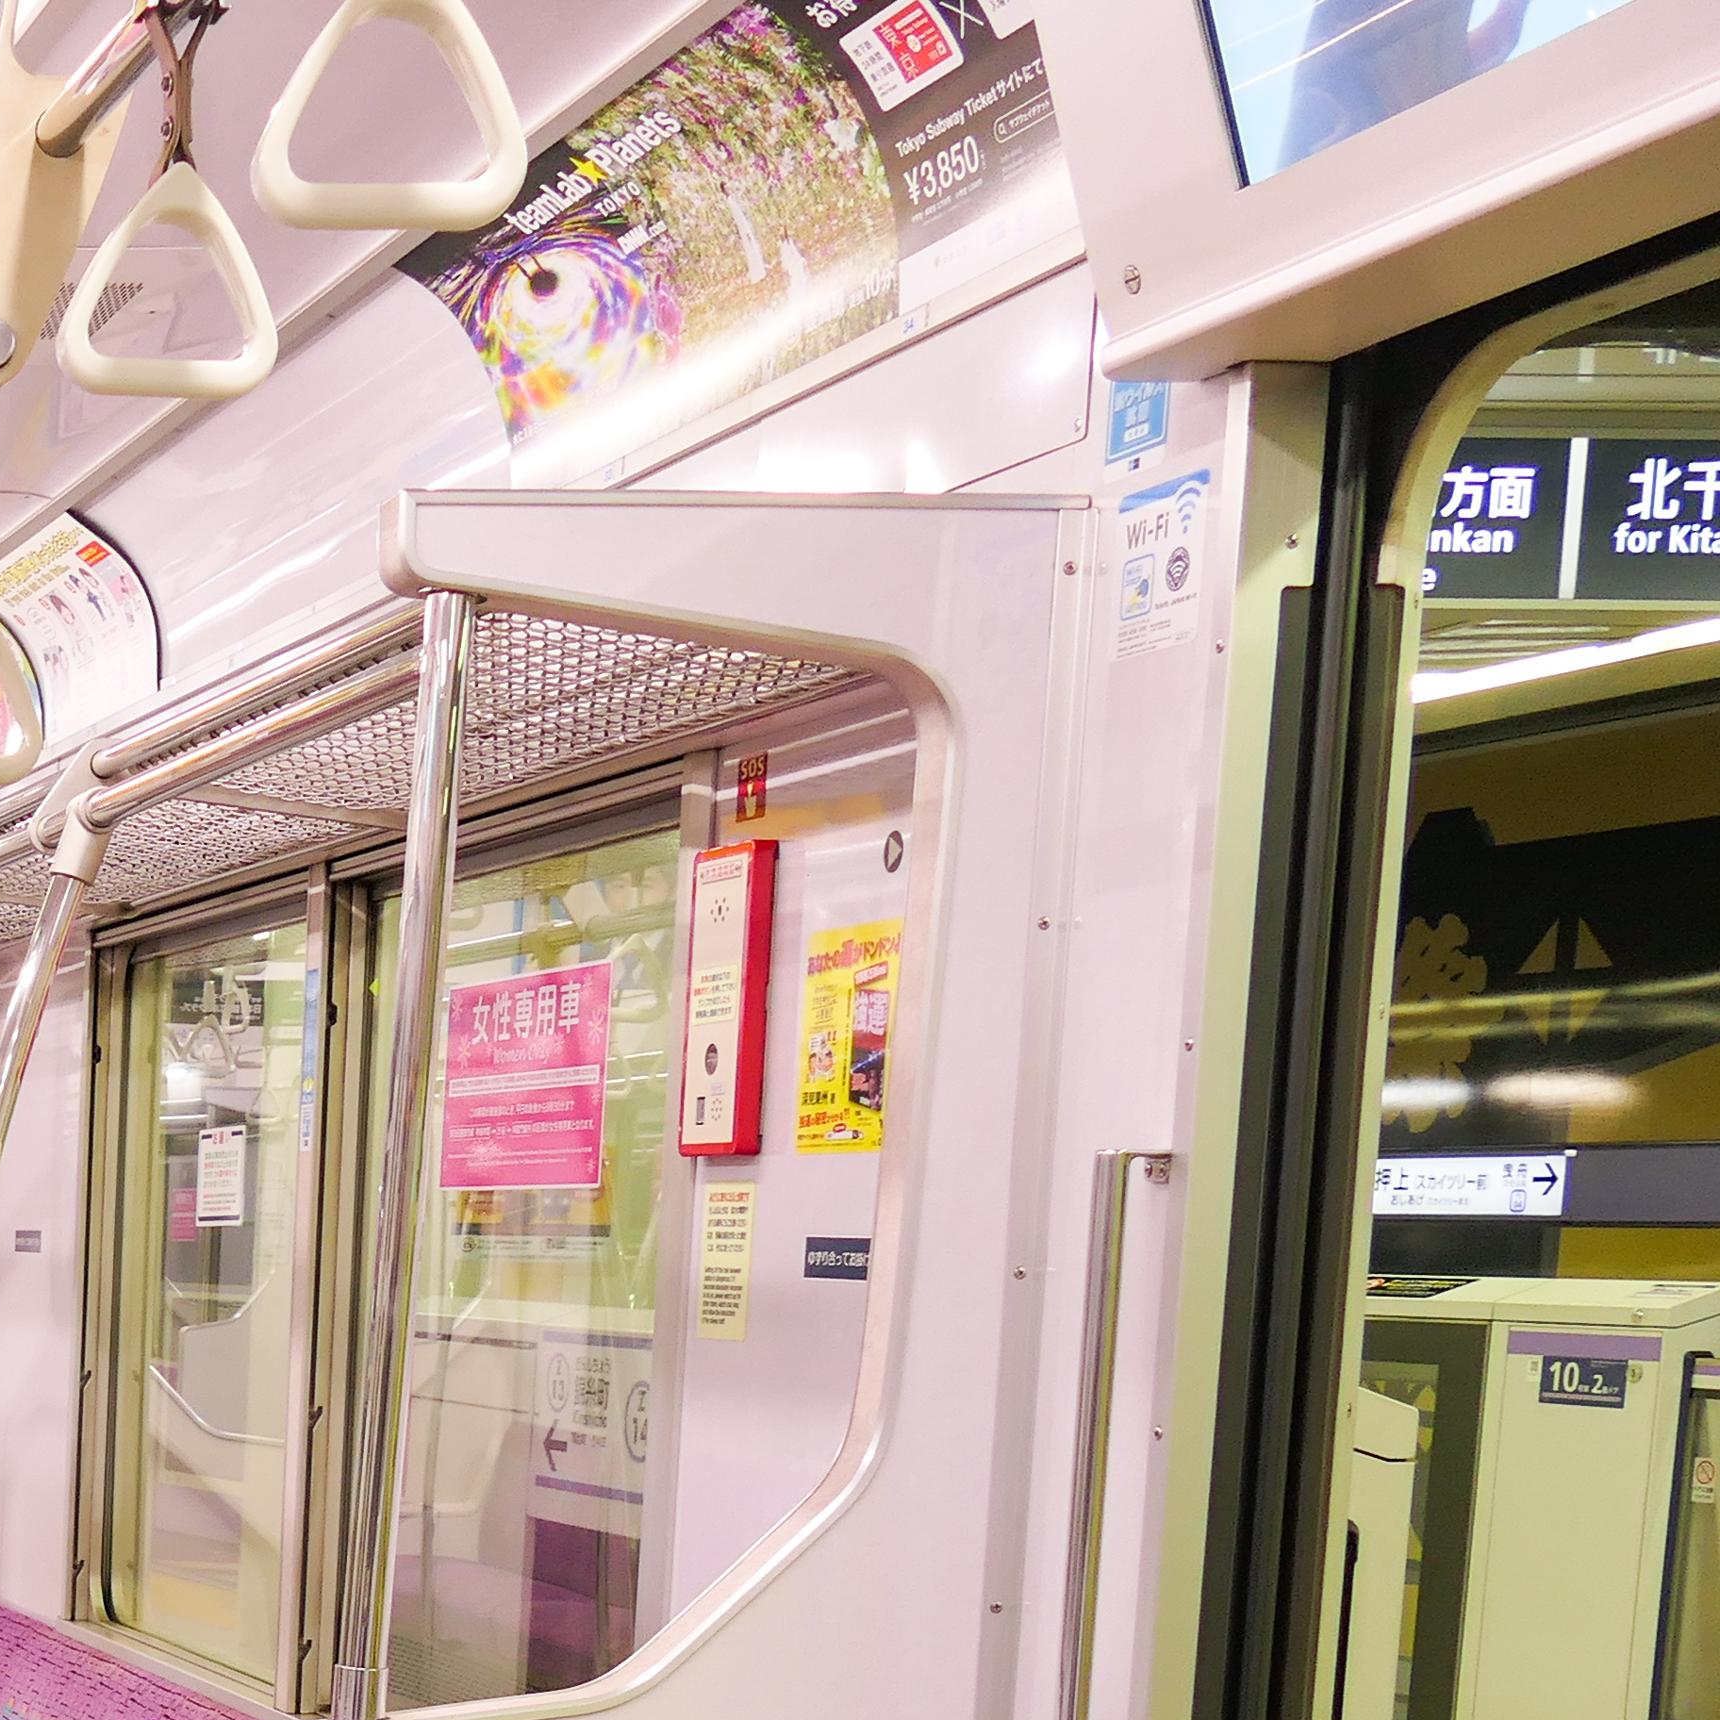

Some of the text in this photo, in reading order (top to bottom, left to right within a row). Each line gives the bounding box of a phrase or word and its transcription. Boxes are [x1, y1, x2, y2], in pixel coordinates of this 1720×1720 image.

[895, 131, 927, 158] Tokyo
[925, 104, 966, 142] Subway
[503, 109, 682, 237] teamLab Planets
[594, 181, 642, 218] TOKYO
[1431, 465, 1537, 519] 方面
[1125, 511, 1171, 551] Wi-Fi
[1425, 520, 1515, 553] nkan
[1613, 521, 1662, 554] for
[740, 754, 765, 780] SOS
[470, 979, 582, 1046] 女性専用車
